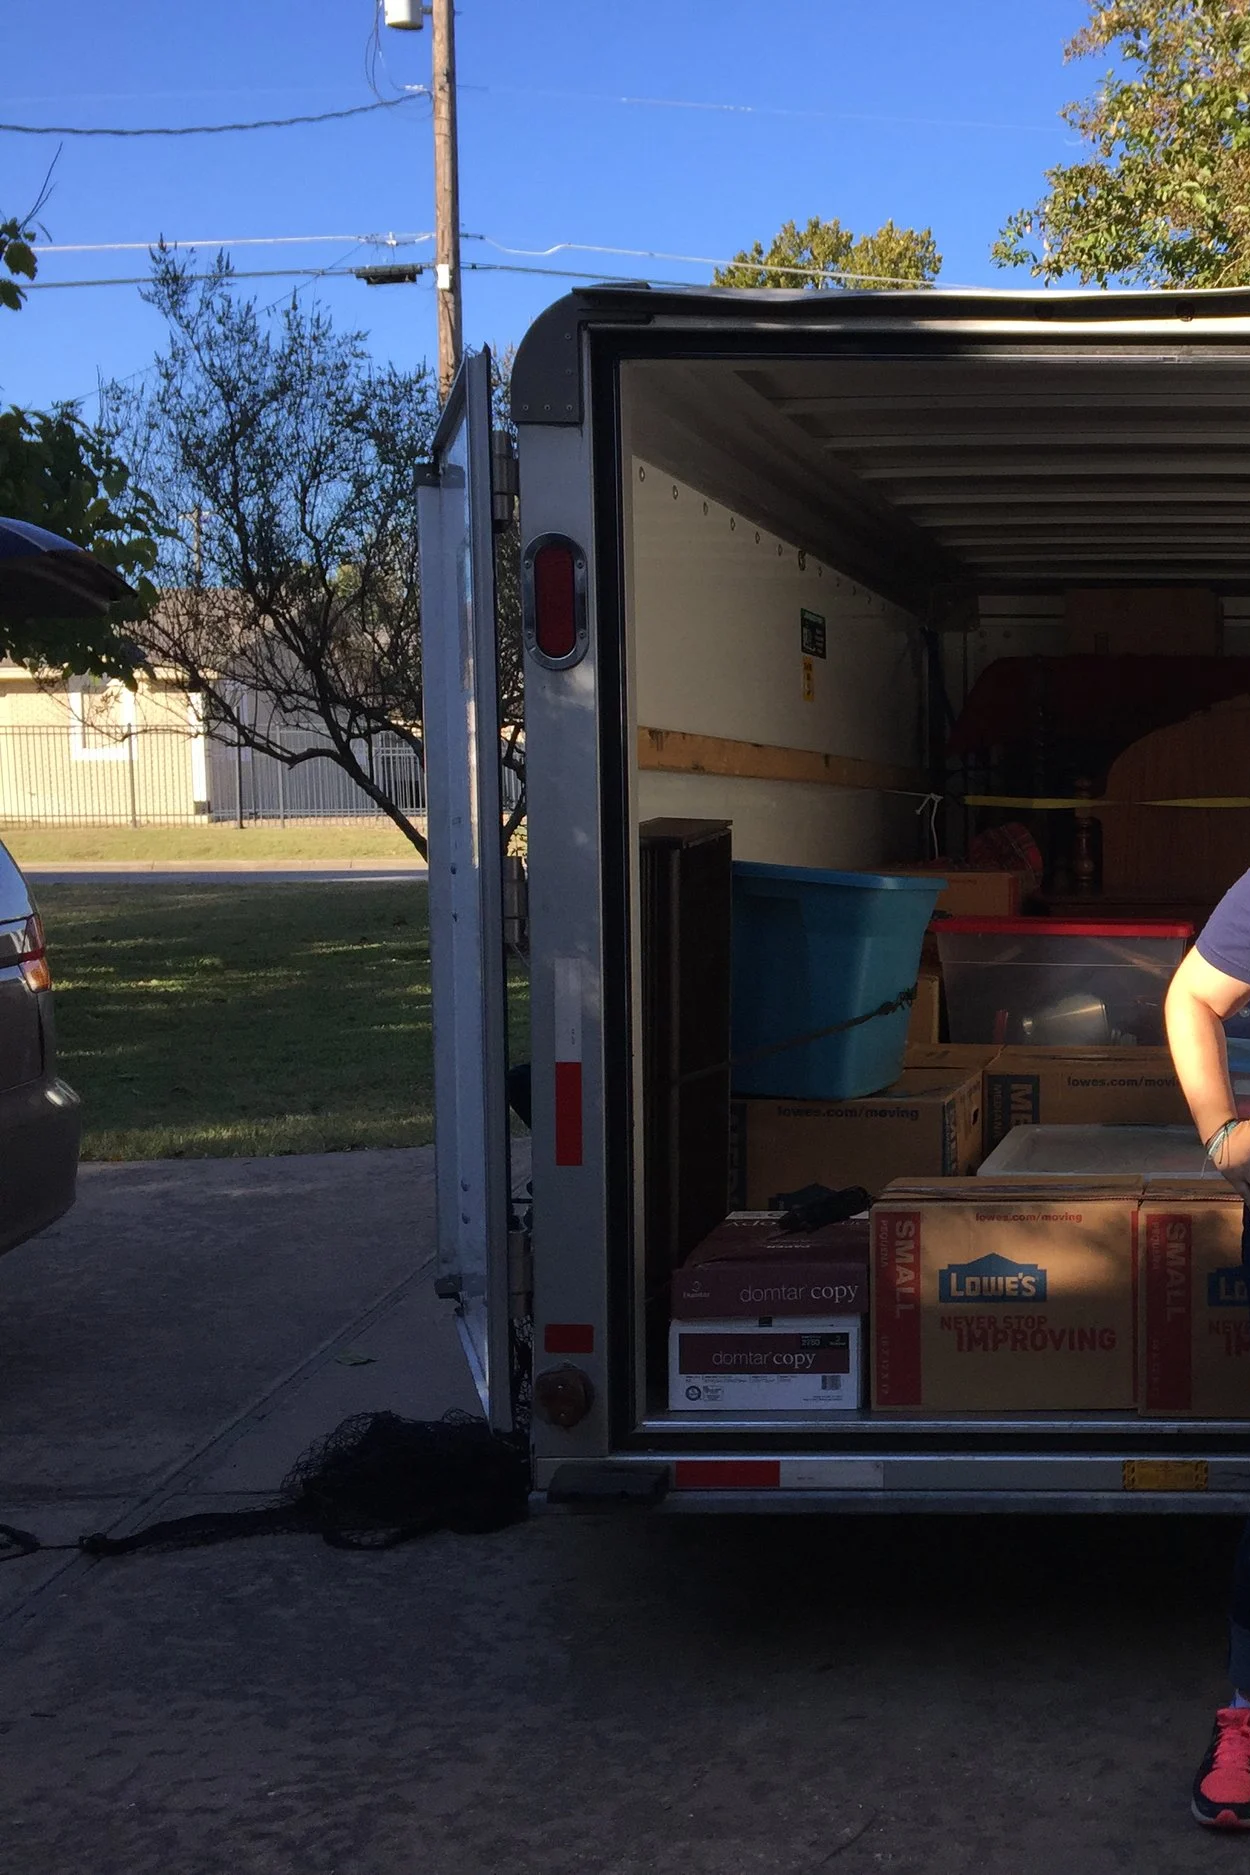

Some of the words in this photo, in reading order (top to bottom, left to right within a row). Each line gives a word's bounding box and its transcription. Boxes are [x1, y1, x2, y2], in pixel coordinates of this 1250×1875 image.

[1067, 1075, 1179, 1087] lowes.com/movi
[777, 1106, 920, 1121] lowes.com/moving
[975, 1212, 1083, 1223] lowes.com/moving
[896, 1220, 916, 1319] SMALL
[1166, 1222, 1188, 1323] SMALL
[739, 1285, 805, 1303] domtar
[810, 1284, 860, 1304] copy
[941, 1315, 997, 1331] NEVER
[1003, 1315, 1048, 1331] STOP
[957, 1327, 1117, 1352] IMPROVING
[712, 1351, 769, 1366] domtar
[772, 1352, 817, 1369] copy
